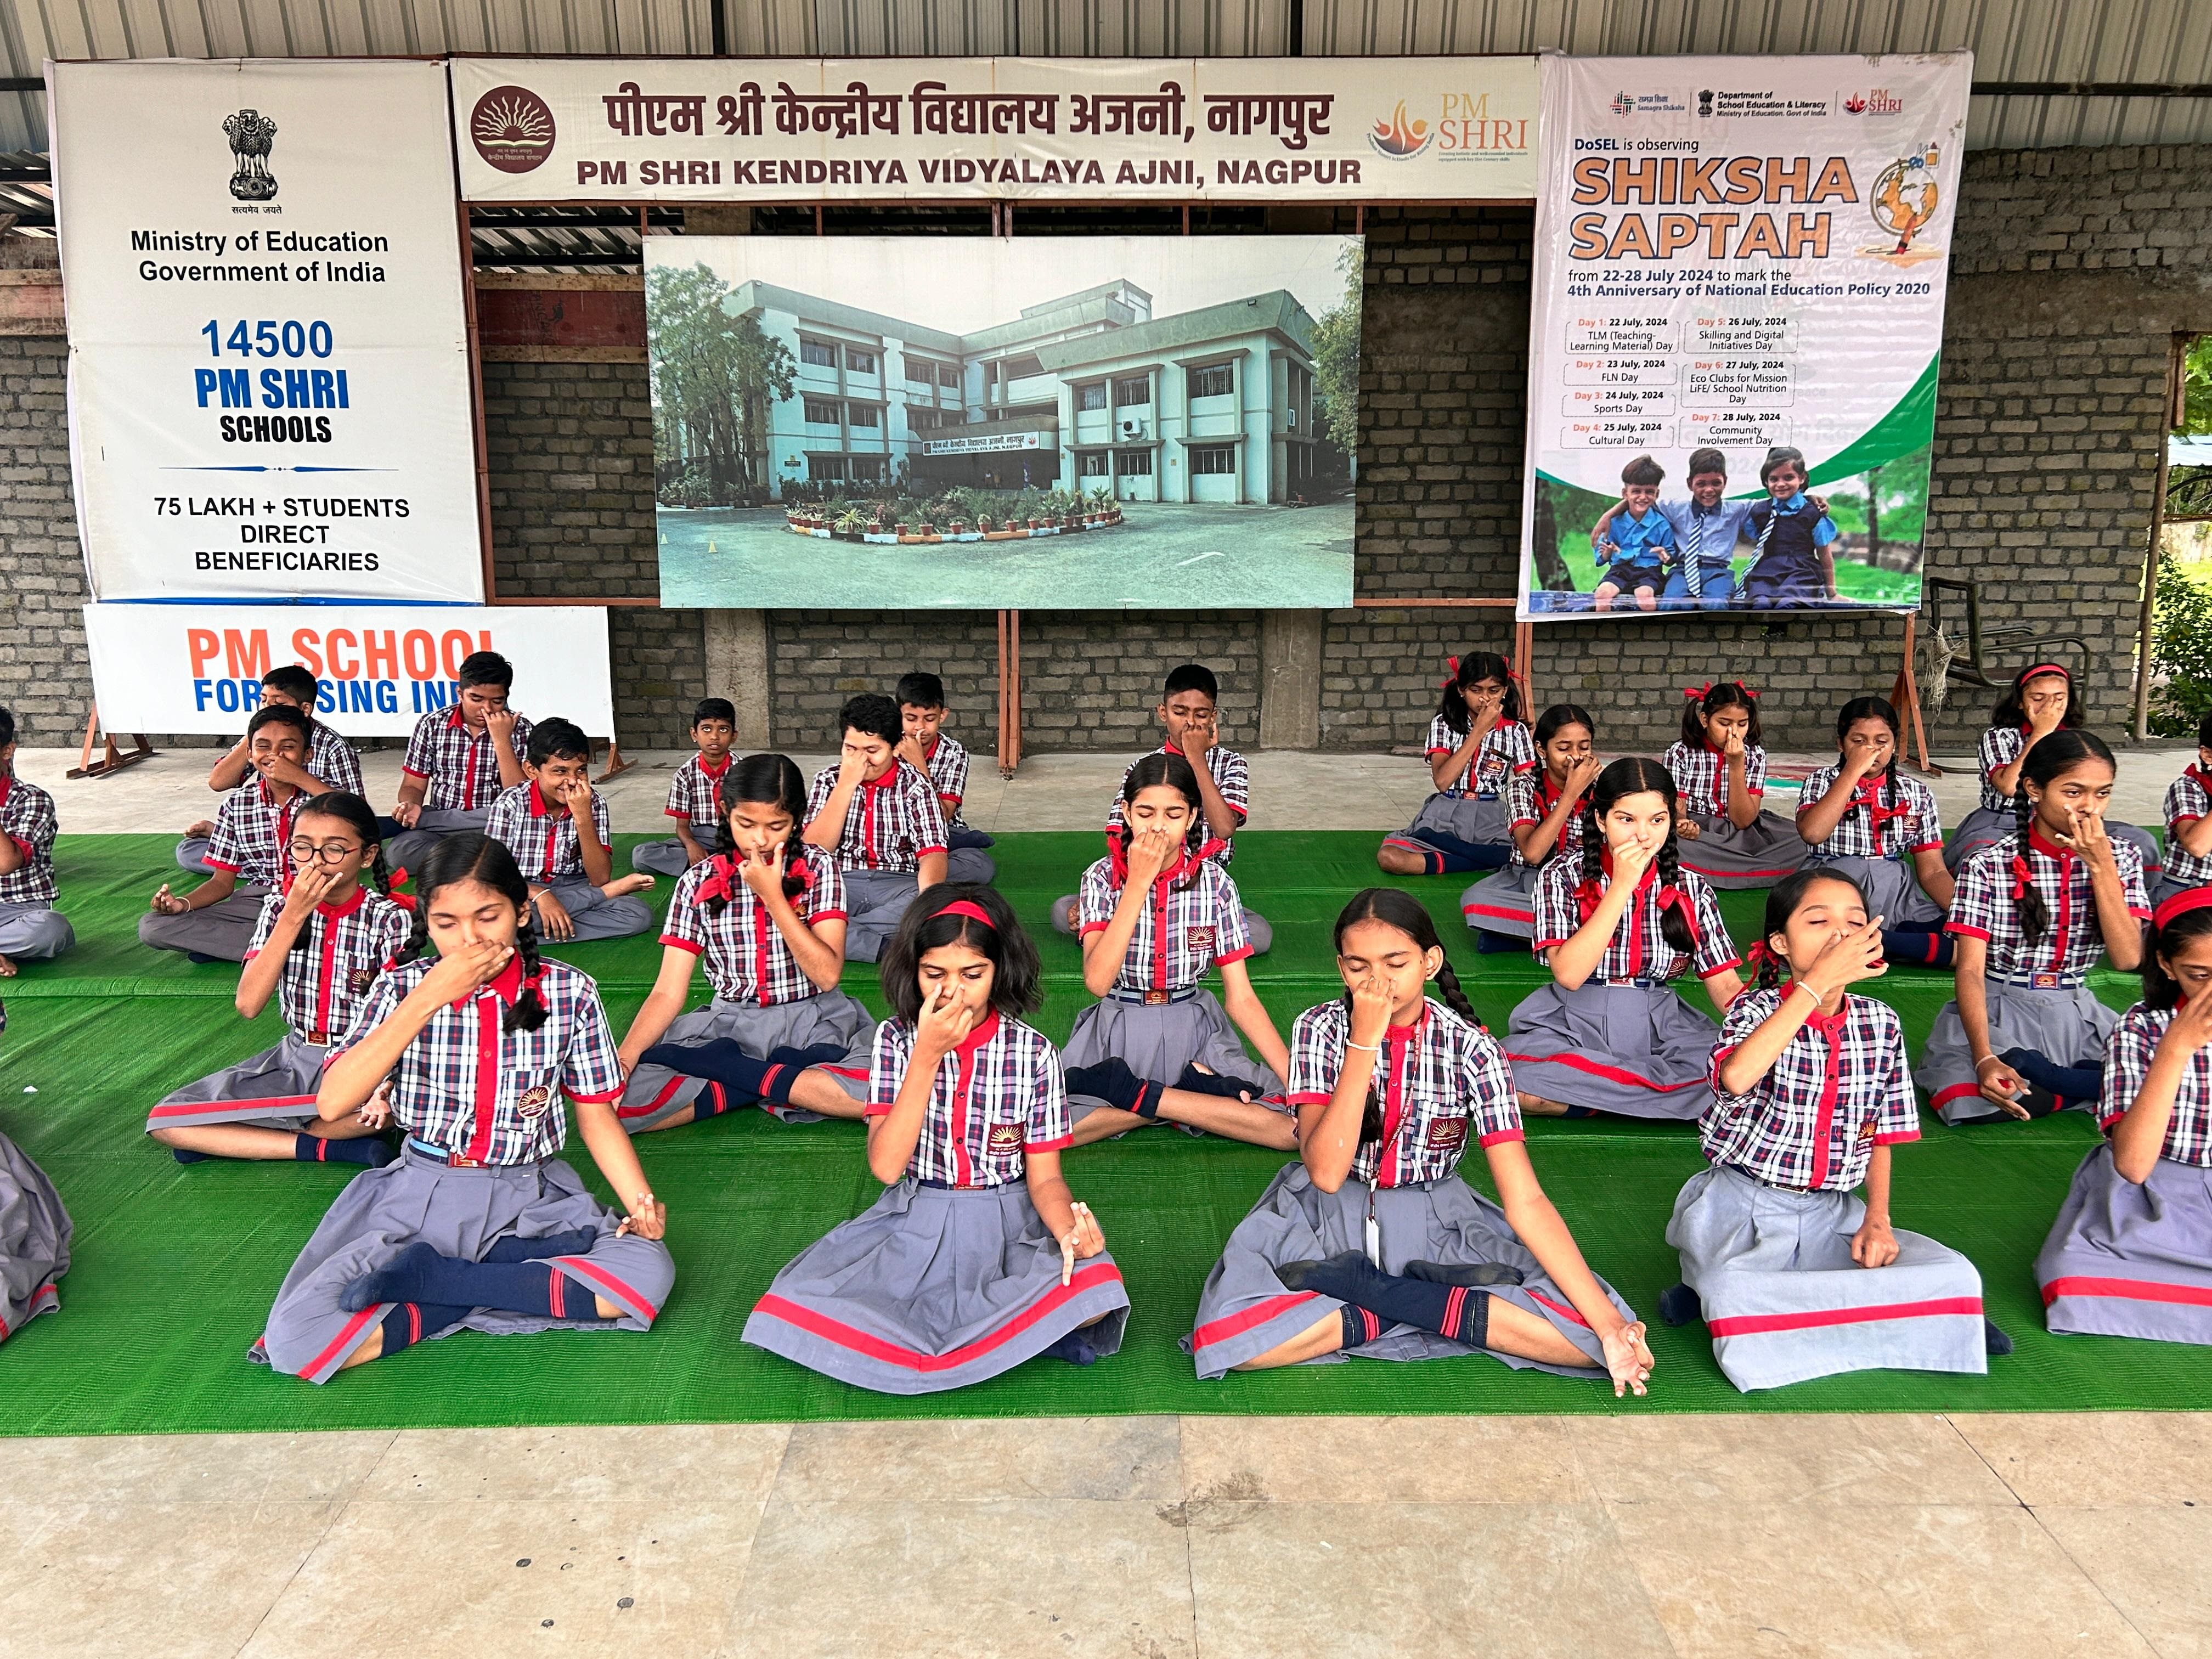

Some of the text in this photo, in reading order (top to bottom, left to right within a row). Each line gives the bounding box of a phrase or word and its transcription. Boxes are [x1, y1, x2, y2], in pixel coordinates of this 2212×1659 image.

[1718, 92, 1763, 100] Department
[1870, 89, 1888, 99] PM
[1441, 93, 1489, 119] PM
[1746, 101, 1786, 109] Education
[1795, 101, 1826, 110] Literacy
[1868, 99, 1903, 110] SHRI
[603, 81, 1334, 150] पीएम श्री केन्द्रीय विद्यालय अजनी, नागपुर
[1438, 120, 1528, 150] SHRI
[1575, 138, 1699, 153] DoSEL is observing
[578, 159, 1362, 188] PM SHRI KENDRIYA VIDYALAYA AJNI, NAGPUR
[1571, 156, 1859, 206] SHIKSHA
[231, 204, 282, 214] सत्यमेव जयते
[1568, 212, 1832, 260] SAPTAH
[131, 231, 388, 256] Ministry of Education
[139, 261, 386, 283] Government of India
[1568, 269, 1791, 284] from 22-28 July 2024 to mark the
[1567, 283, 1931, 299] 4th Anniversary of National Education Policy 2020
[1578, 319, 1595, 328] Day
[1622, 318, 1643, 328] July,
[1697, 318, 1714, 328] Day
[1742, 318, 1762, 327] July,
[201, 319, 333, 358] 14500
[1588, 331, 1656, 341] TLM (Teaching-
[1699, 330, 1784, 341] Skilling and Digital
[1570, 341, 1673, 352] Learning Material) Day
[1709, 341, 1773, 351] Initiatives Day
[1576, 360, 1594, 370] Day
[1620, 360, 1640, 369] July,
[1695, 362, 1712, 371] Day
[1739, 361, 1759, 370] July,
[1602, 373, 1638, 383] FLN Day
[1691, 373, 1787, 382] Eco Clubs for Mission
[194, 369, 349, 409] PM SHRI
[1690, 385, 1711, 393] LiFE/
[1713, 384, 1743, 393] School
[1746, 384, 1786, 392] Nutrition
[1575, 392, 1592, 401] Day
[1619, 391, 1639, 400] July,
[1729, 395, 1747, 405] Day
[1594, 404, 1643, 415] Sports Day
[1692, 414, 1709, 422] Day
[1736, 413, 1756, 422] July,
[219, 415, 331, 443] SCHOOLS
[1573, 424, 1590, 433] Day
[1617, 423, 1637, 432] July,
[1709, 425, 1762, 436] Community
[1589, 436, 1645, 446] Cultural Day
[1697, 436, 1773, 445] Involvement Day
[154, 497, 410, 518] 75 LAKH + STUDENTS
[241, 525, 330, 544] DIRECT
[195, 552, 380, 572] BENEFICIARIES
[187, 629, 271, 679] PM
[194, 679, 262, 712] FOR
[316, 680, 398, 713] SING
